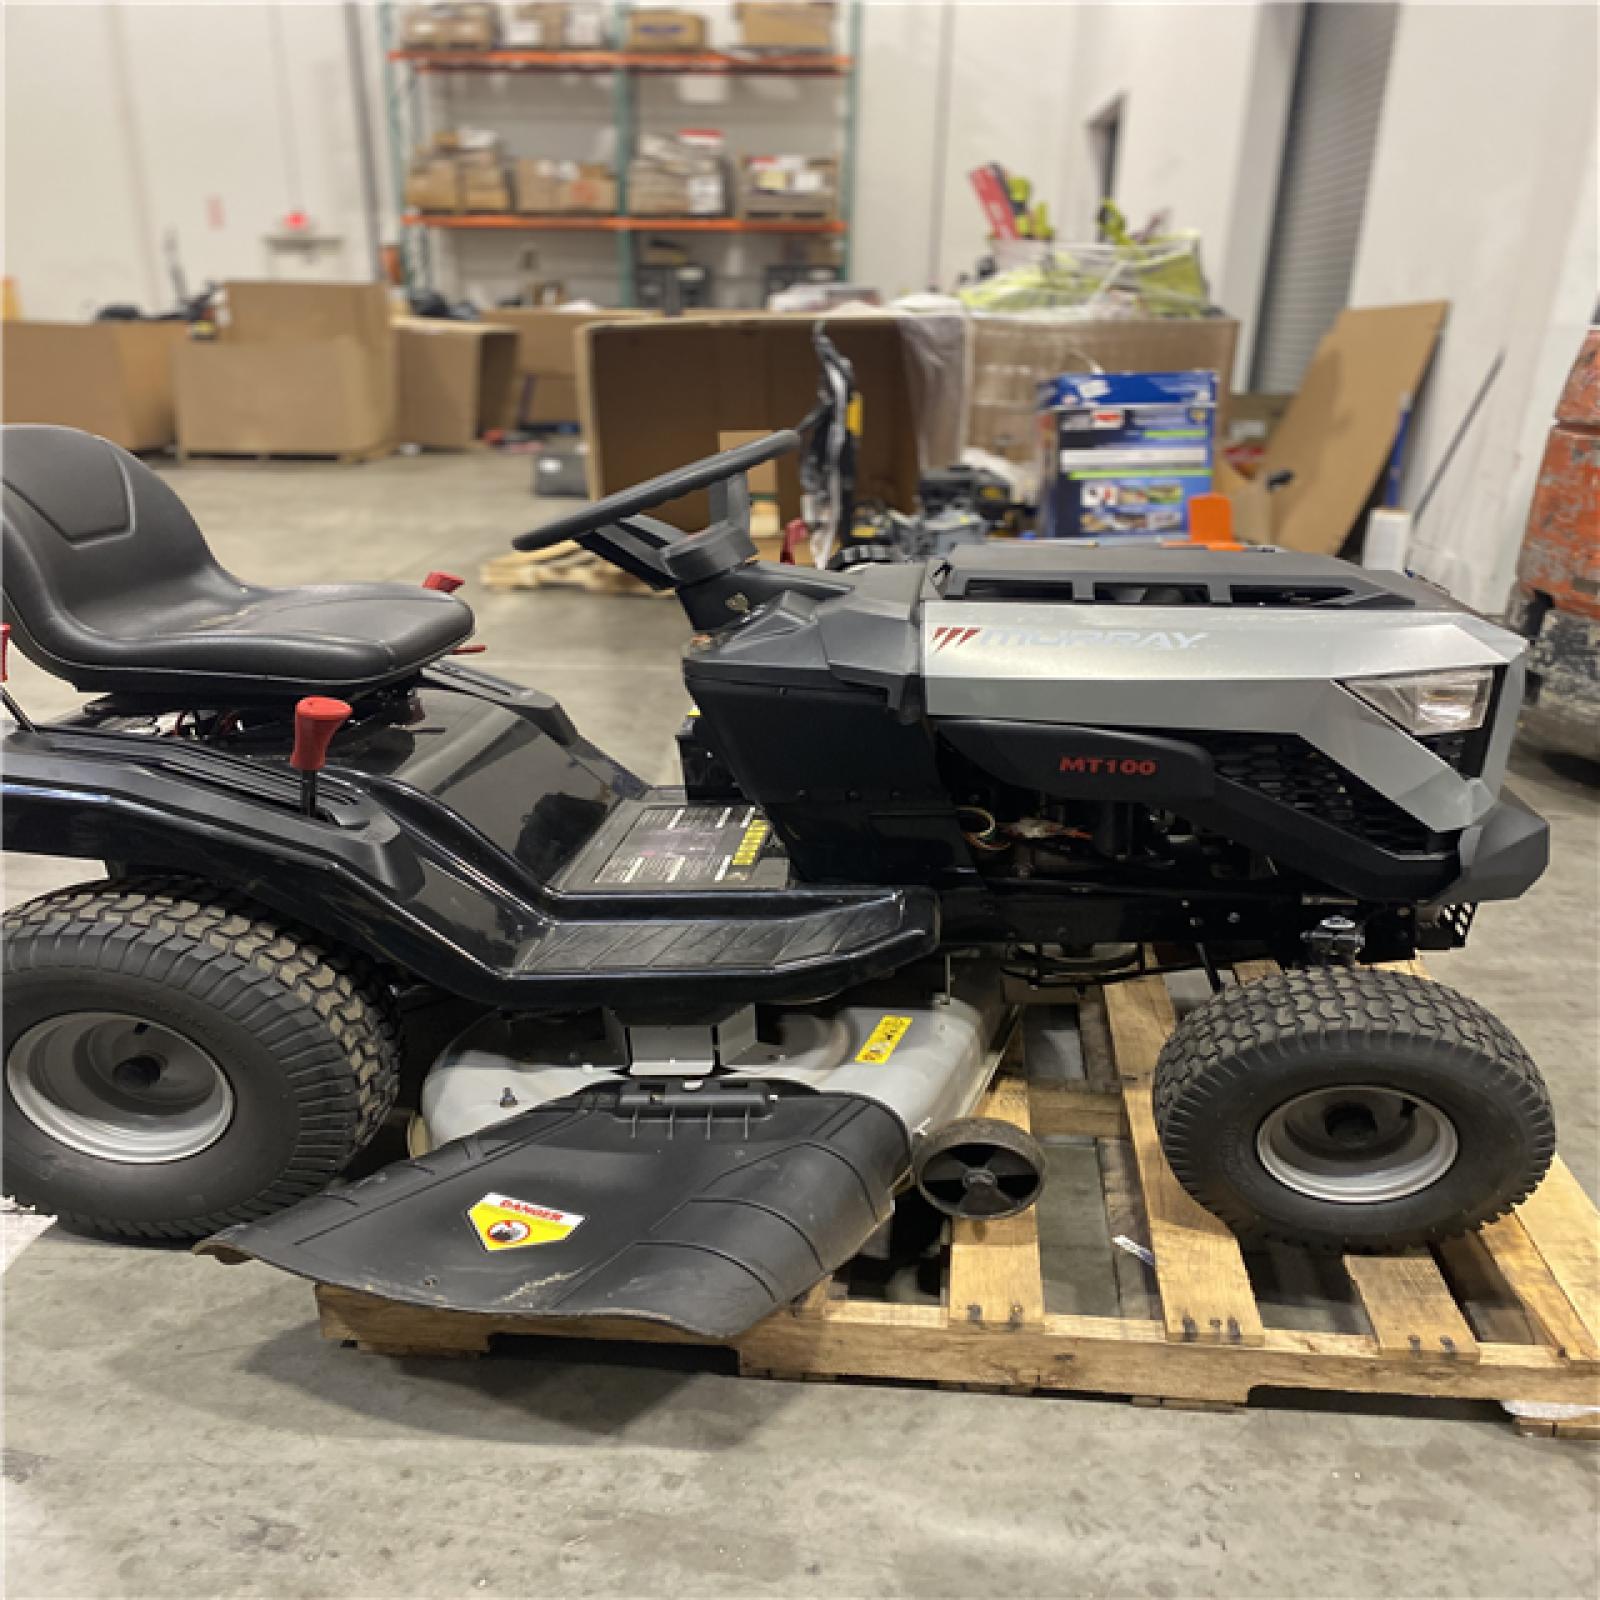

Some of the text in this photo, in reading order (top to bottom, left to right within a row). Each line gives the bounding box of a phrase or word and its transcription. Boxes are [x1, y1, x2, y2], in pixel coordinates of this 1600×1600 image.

[979, 628, 1208, 649] MURRAY
[1059, 757, 1156, 776] MT100
[500, 1199, 563, 1220] DANGER
